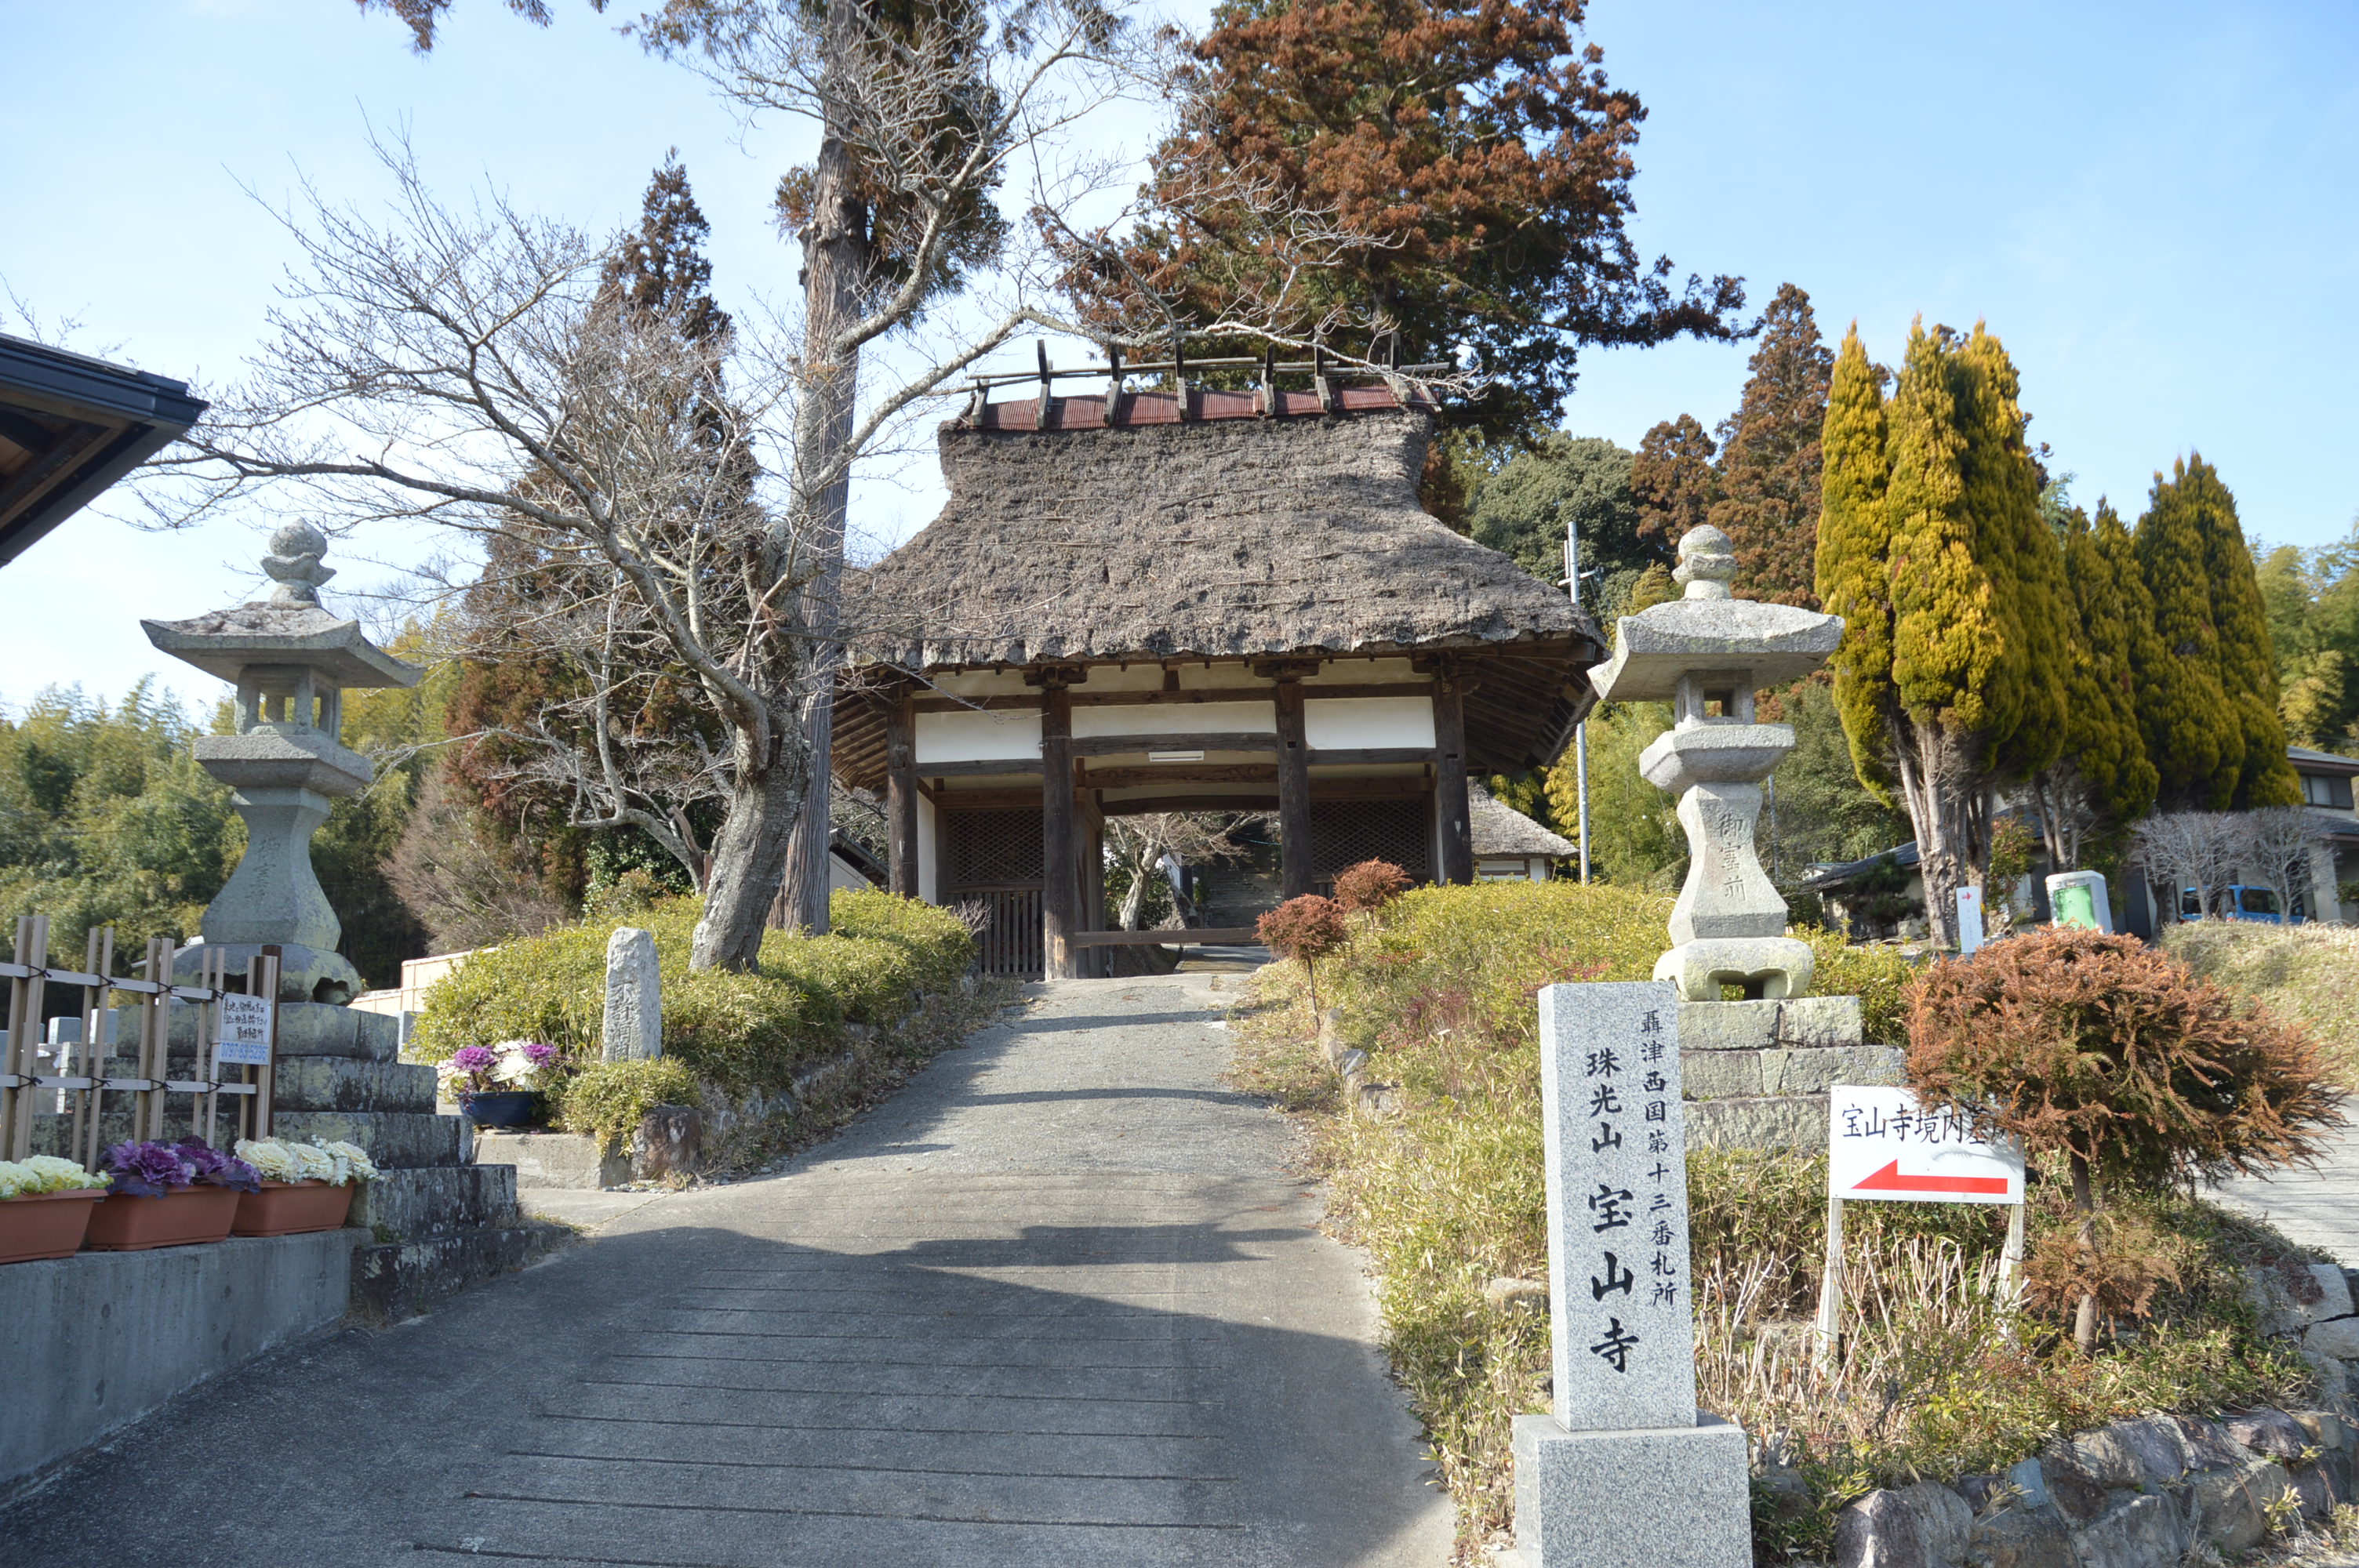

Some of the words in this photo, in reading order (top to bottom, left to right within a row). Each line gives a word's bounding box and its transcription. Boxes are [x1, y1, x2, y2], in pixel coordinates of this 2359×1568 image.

[1587, 1047, 1622, 1154] 珠光山
[1588, 1184, 1640, 1374] 宝山寺
